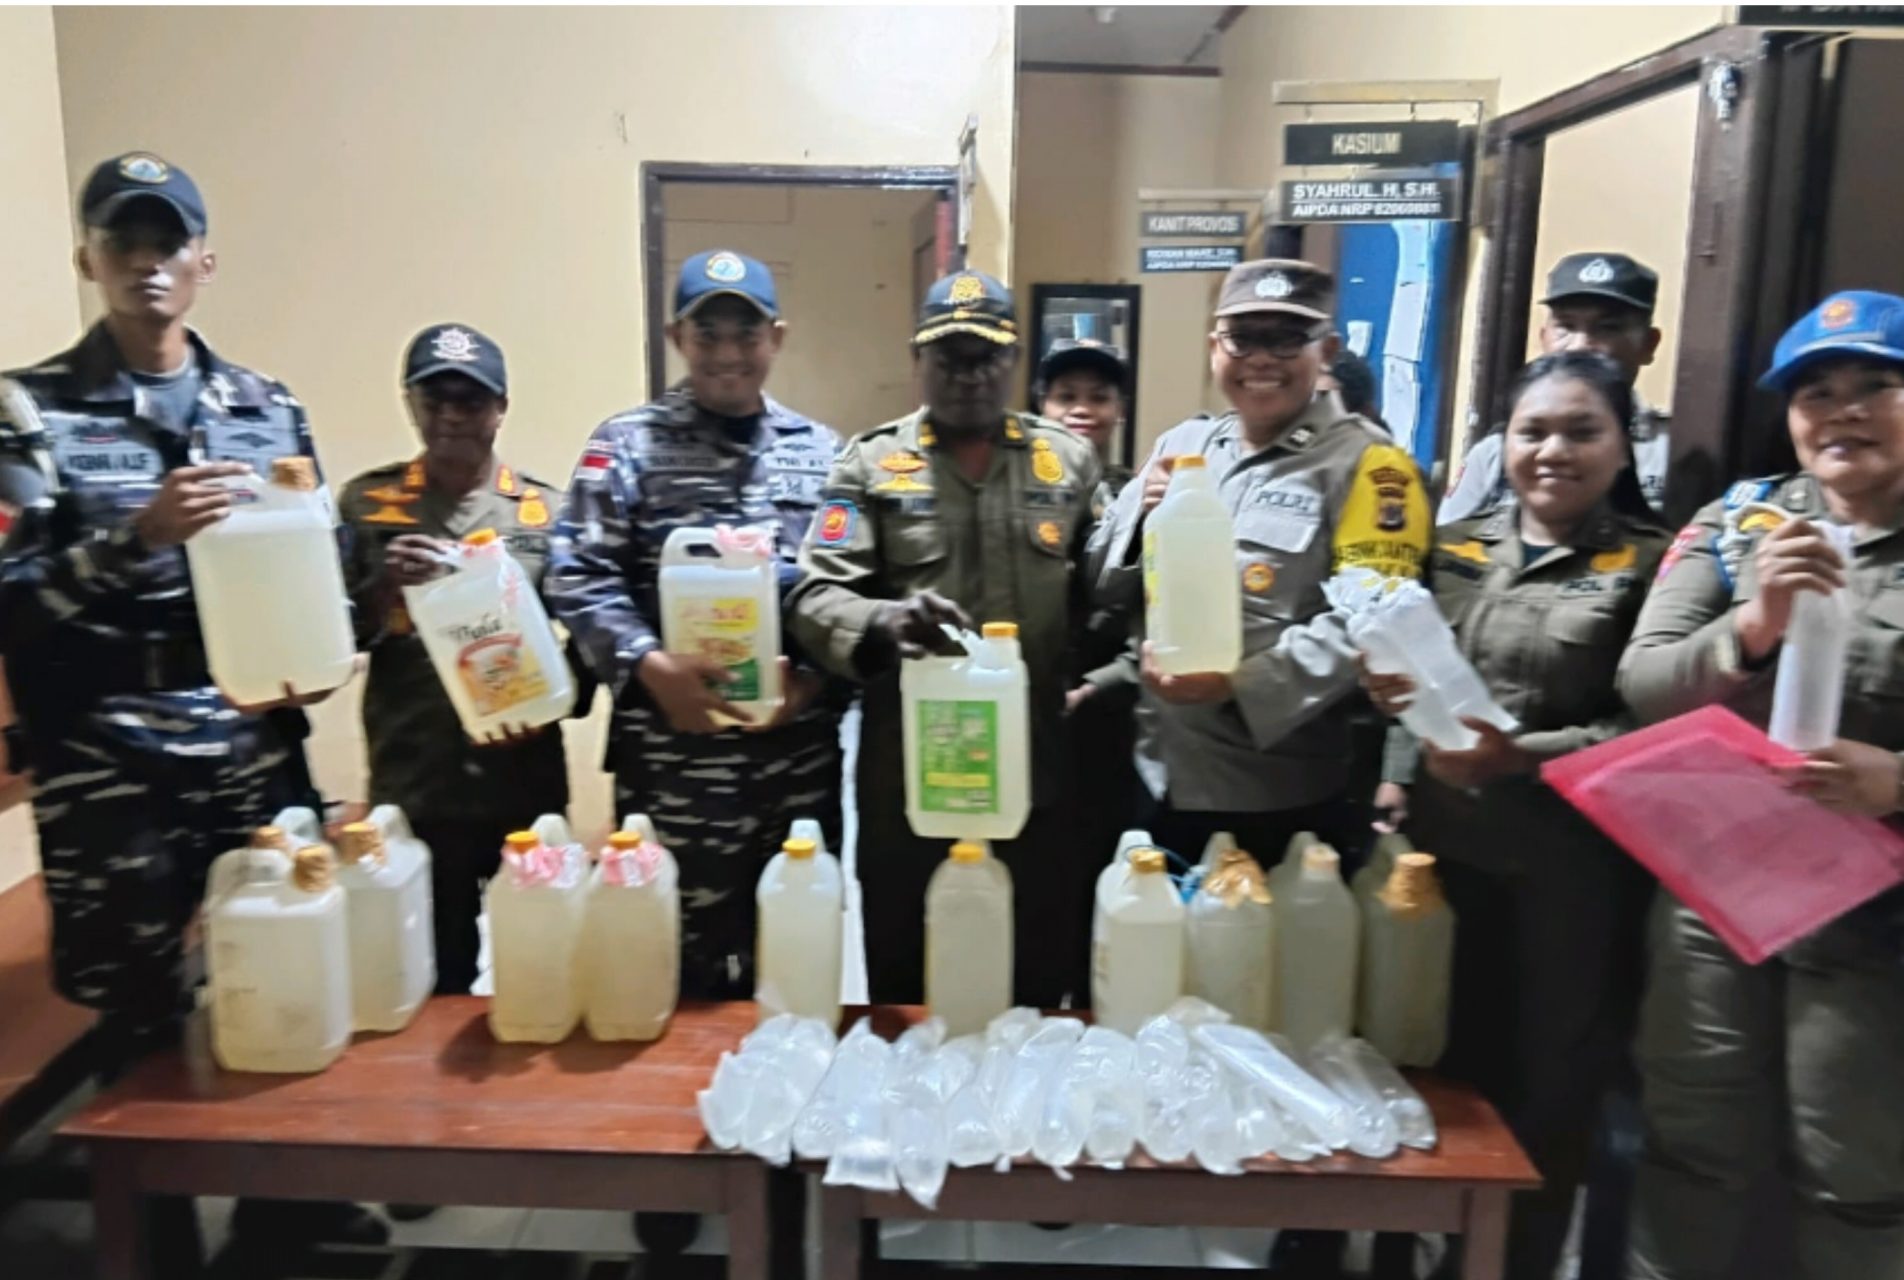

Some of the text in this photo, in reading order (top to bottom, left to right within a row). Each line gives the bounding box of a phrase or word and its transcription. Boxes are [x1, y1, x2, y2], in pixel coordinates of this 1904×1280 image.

[1331, 132, 1402, 155] KASIUM
[1148, 216, 1239, 233] KANIT PROVOS
